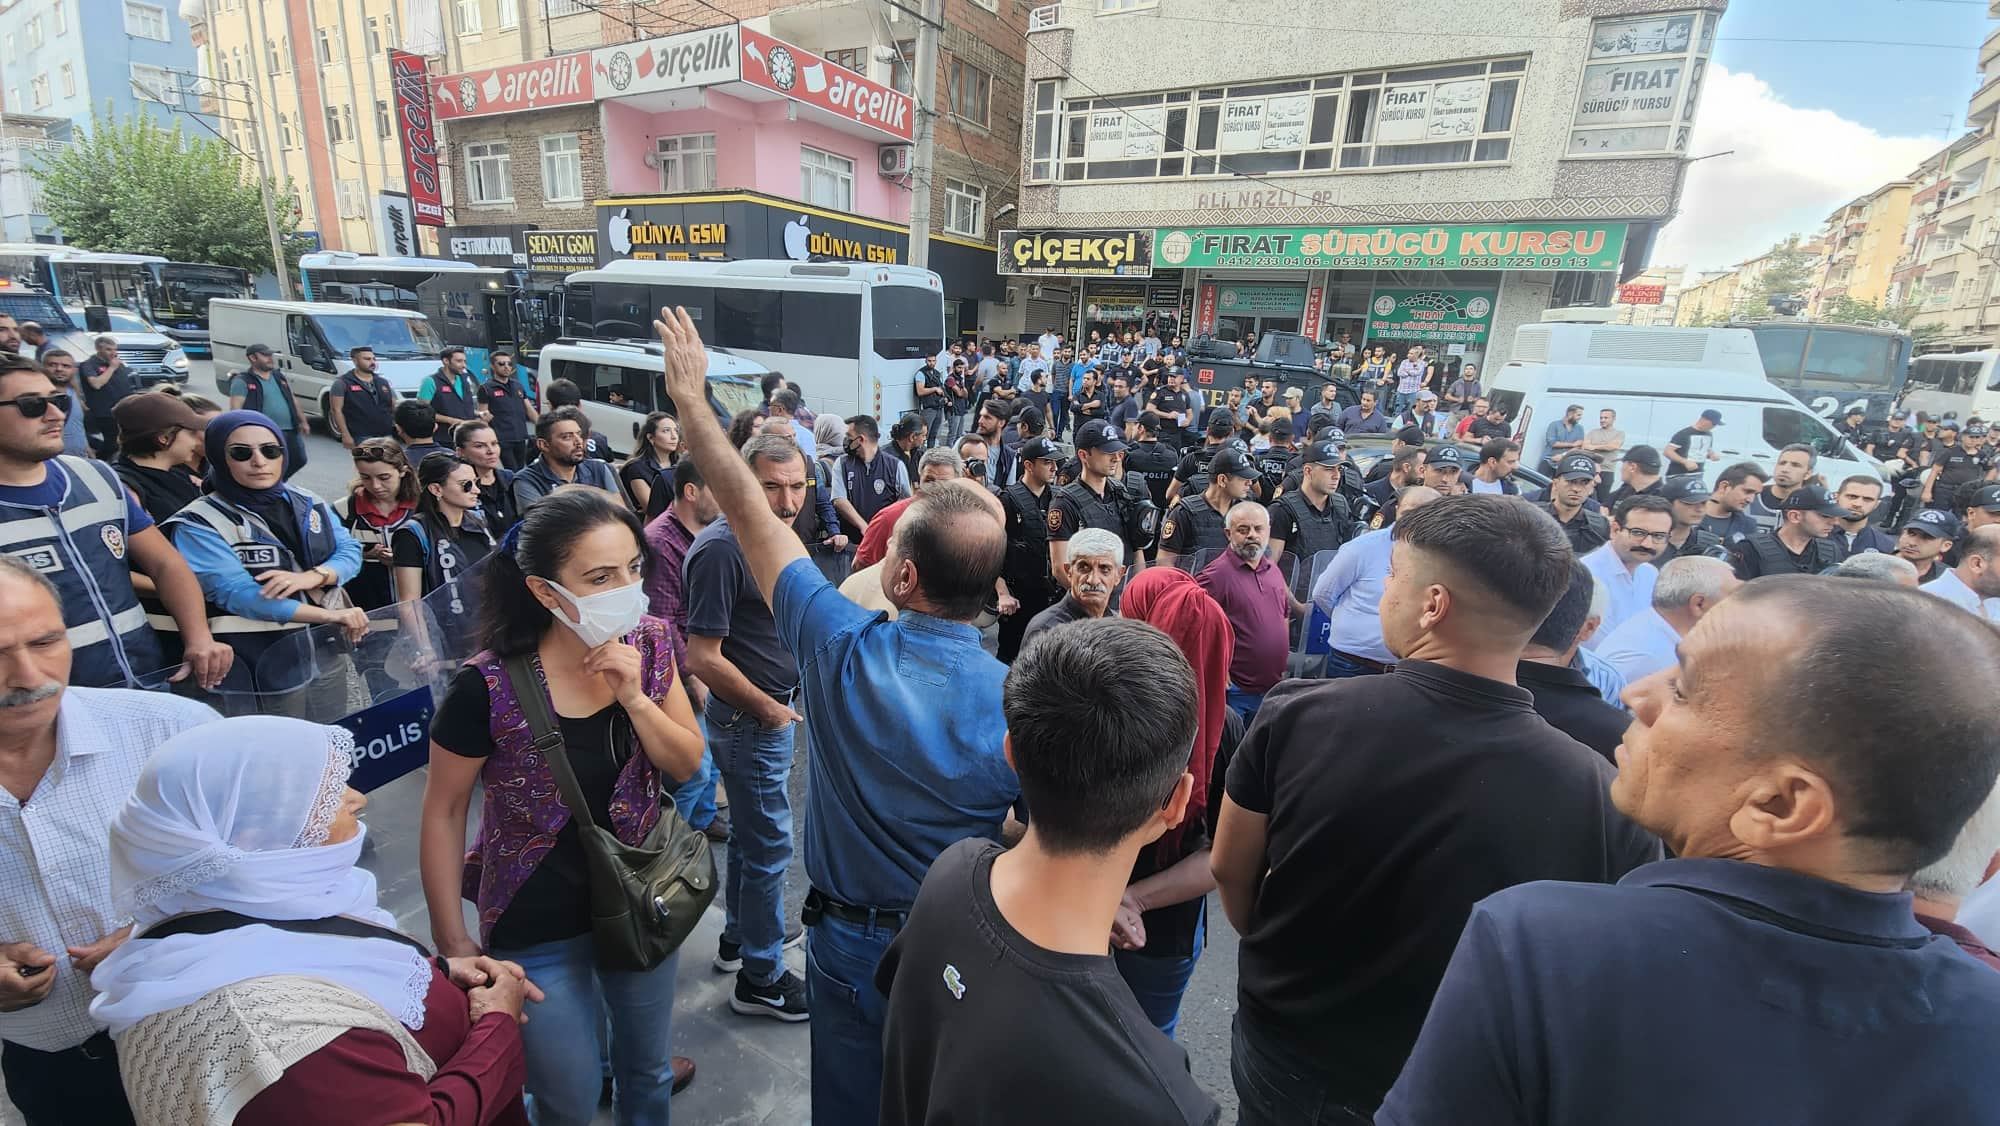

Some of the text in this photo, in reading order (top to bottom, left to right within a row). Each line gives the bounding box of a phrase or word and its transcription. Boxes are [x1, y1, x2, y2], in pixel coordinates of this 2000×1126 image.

[656, 31, 733, 83] arçelik
[503, 57, 583, 107] arçelik
[1610, 68, 1679, 92] FIRAT
[828, 75, 907, 130] arçelik
[1228, 104, 1261, 117] FIRAT
[1386, 91, 1427, 105] FIRAT
[1582, 96, 1672, 113] SÜRÜCÜ KURSU
[395, 60, 437, 195] arçelik
[1093, 116, 1122, 128] FIRAT
[387, 205, 409, 255] arçelik
[631, 220, 726, 244] DÜNYA GSM
[1203, 228, 1606, 256] FIRAT SÜRÜCÜ KURSU
[450, 236, 513, 258] ÇETİNKAYA
[528, 234, 595, 254] SEDAT GSM
[810, 231, 897, 264] DÜNYA GSM
[1013, 232, 1136, 267] ÇİÇEKÇİ
[1217, 256, 1252, 266] 0.412
[1255, 256, 1280, 266] 233
[1283, 256, 1299, 266] 04
[1303, 257, 1320, 266] 06
[1333, 256, 1367, 266] 0534
[1372, 256, 1399, 266] 357
[1403, 257, 1422, 266] 97
[1428, 257, 1445, 266] 14
[1460, 257, 1499, 267] 0533
[1505, 257, 1535, 267] 725
[1541, 257, 1561, 267] 09
[1569, 257, 1589, 267] 13
[236, 549, 272, 561] OLİS
[438, 539, 464, 614] POLİS
[350, 722, 422, 769] POLİS
